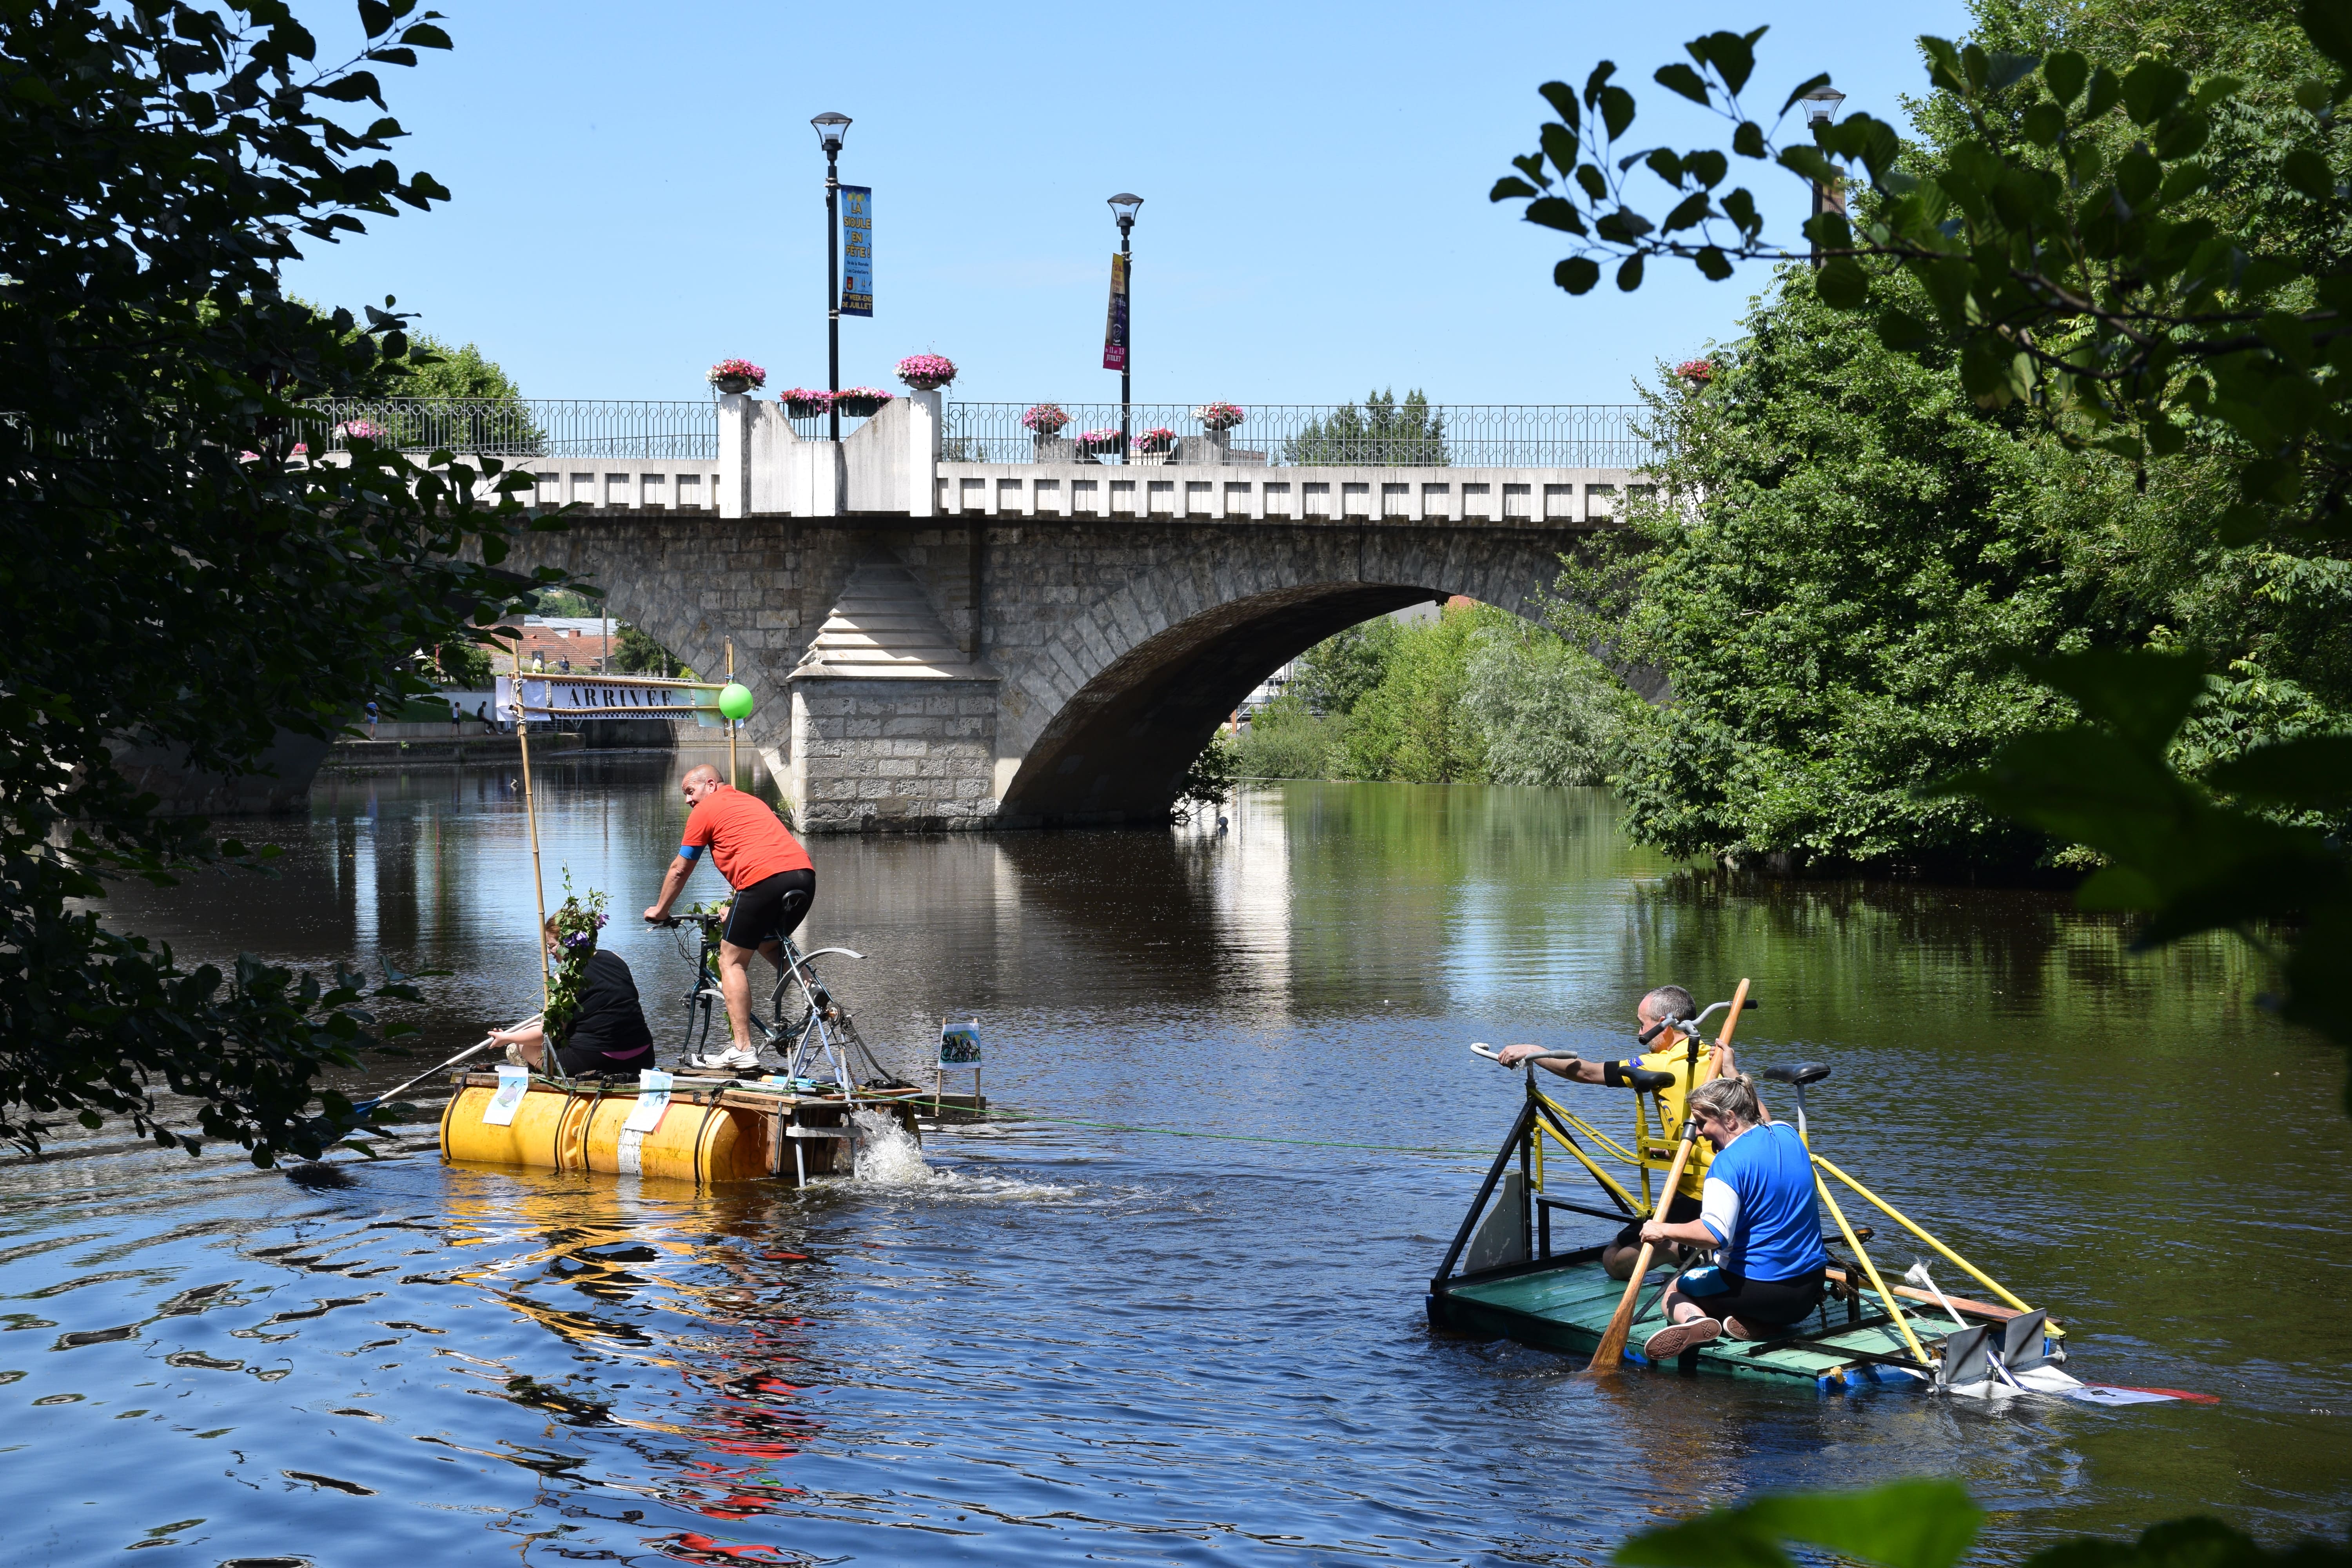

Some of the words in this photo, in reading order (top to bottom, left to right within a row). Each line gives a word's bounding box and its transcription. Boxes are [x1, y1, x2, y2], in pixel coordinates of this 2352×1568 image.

[851, 202, 862, 214] LA
[844, 216, 871, 229] SIOULE
[851, 231, 862, 243] EN
[849, 301, 872, 310] JUILLET
[569, 686, 673, 706] ARRIVÉE
